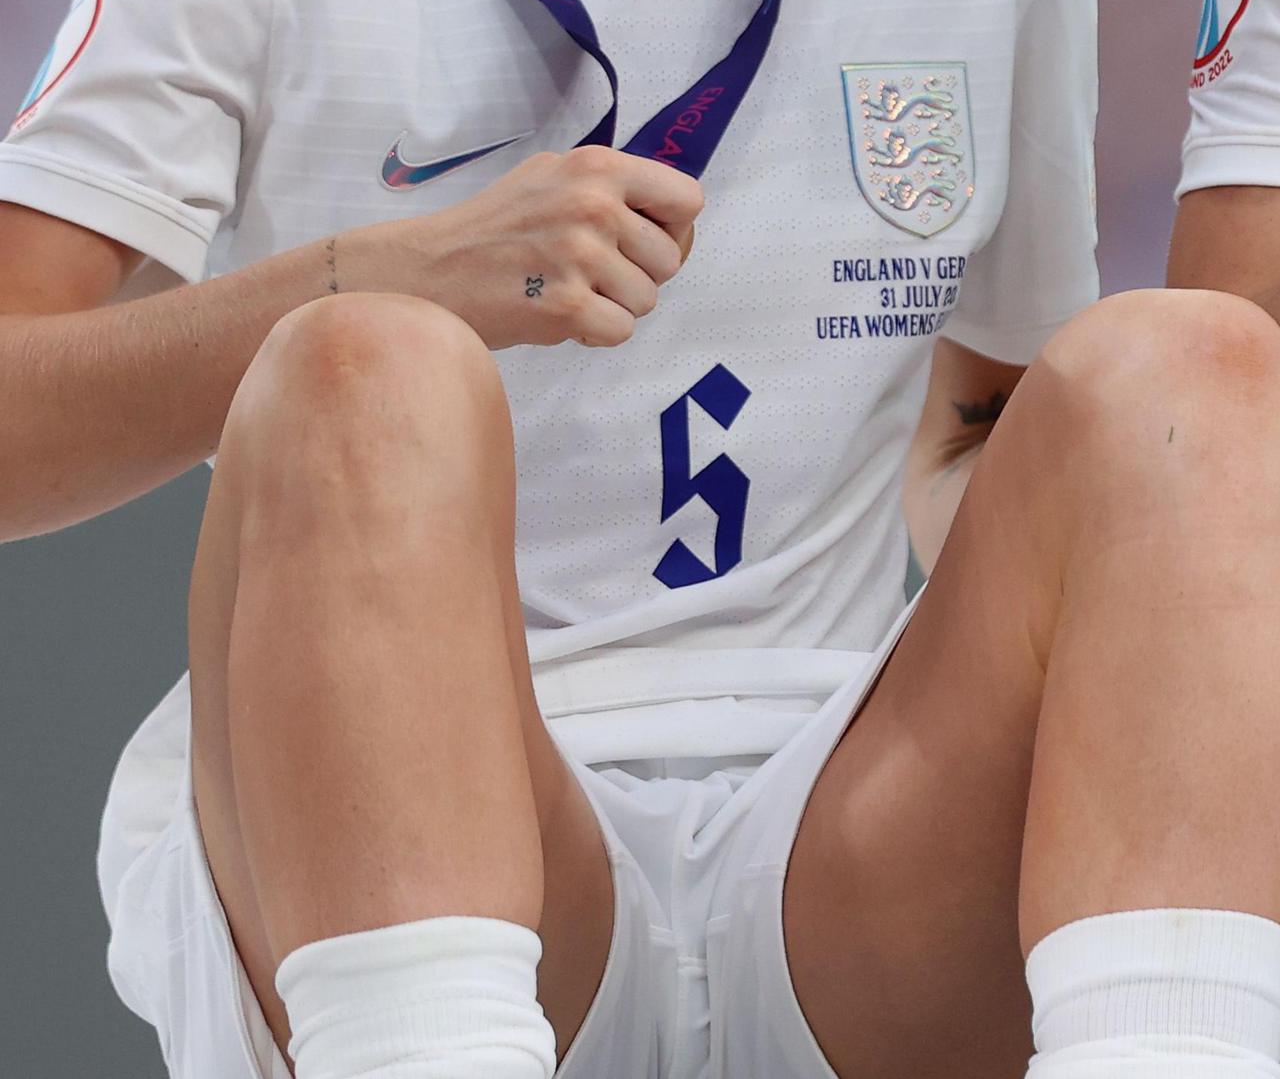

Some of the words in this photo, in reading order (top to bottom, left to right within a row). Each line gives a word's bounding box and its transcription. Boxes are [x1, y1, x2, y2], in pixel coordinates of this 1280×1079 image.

[1208, 49, 1234, 82] 2022
[833, 258, 916, 282] ENGLAND
[920, 258, 931, 279] V
[881, 287, 898, 308] 31
[903, 285, 942, 308] JULY
[816, 316, 863, 339] UEFA
[865, 314, 934, 338] WOMENS
[652, 363, 752, 589] 5
